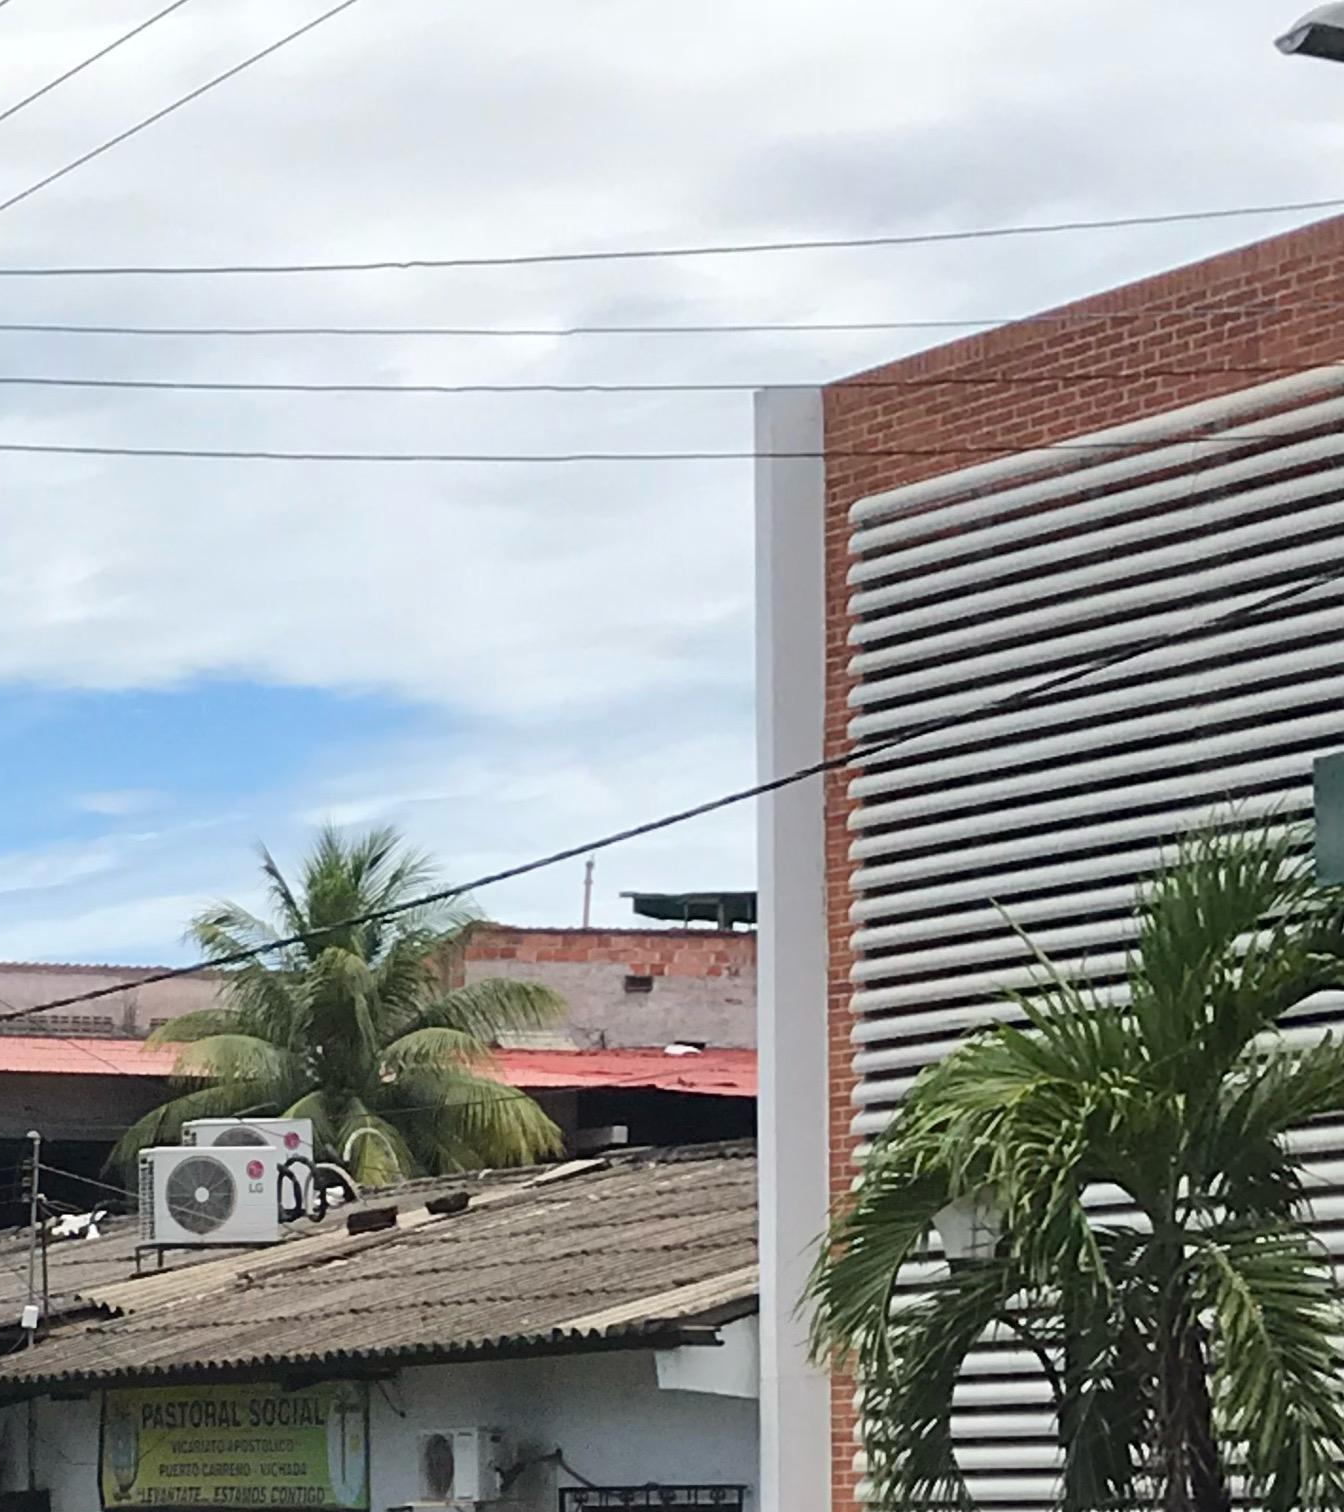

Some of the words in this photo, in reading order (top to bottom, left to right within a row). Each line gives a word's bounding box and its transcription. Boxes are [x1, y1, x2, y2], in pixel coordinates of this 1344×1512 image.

[248, 1182, 264, 1194] LG
[141, 1400, 240, 1429] PASTORAL
[249, 1398, 324, 1427] SOCIAL
[158, 1463, 200, 1477] PUERTO
[260, 1462, 307, 1477] VICHADA
[214, 1486, 267, 1503] ESTAMOS
